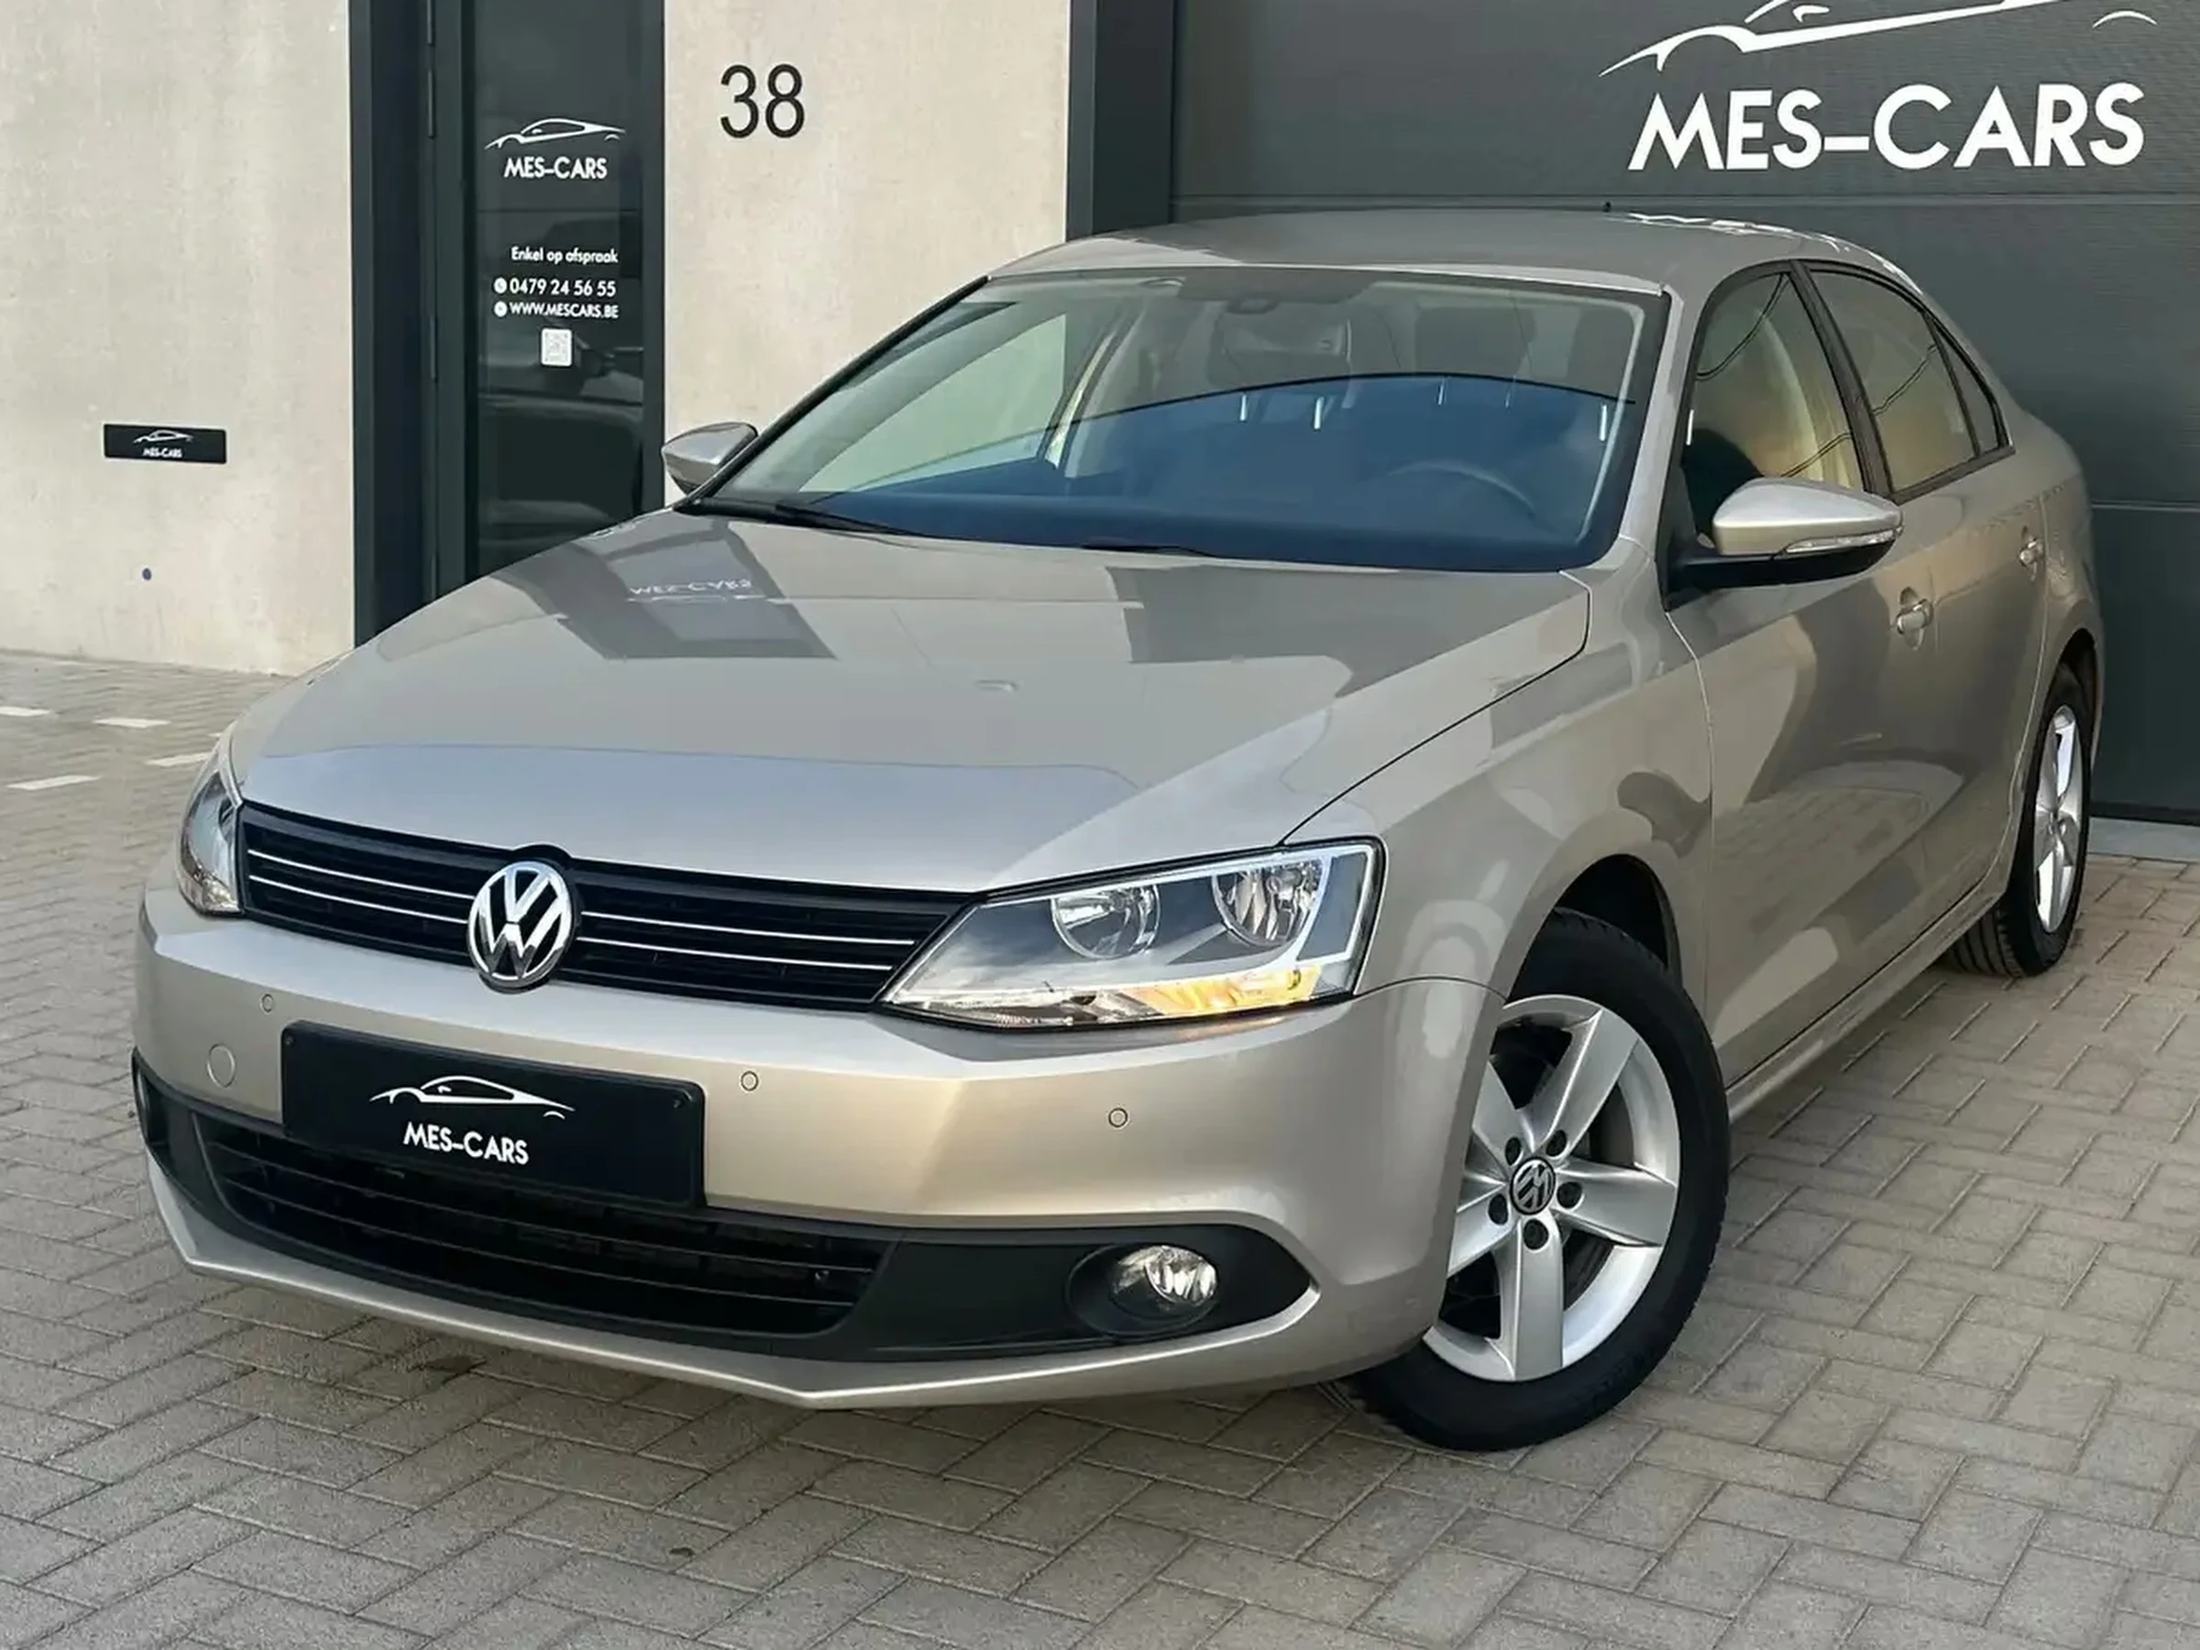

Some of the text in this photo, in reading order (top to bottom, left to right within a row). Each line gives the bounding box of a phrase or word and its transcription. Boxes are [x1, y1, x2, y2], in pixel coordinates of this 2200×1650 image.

[720, 64, 805, 138] 38
[1628, 82, 2145, 171] MES-CARS
[504, 156, 607, 179] MES-CARS
[511, 246, 619, 266] Enkel op afspraak
[509, 278, 617, 297] 0479 24 56 55
[508, 301, 620, 319] WWW.MESCARS.BE
[403, 1121, 529, 1165] MES-CARS
